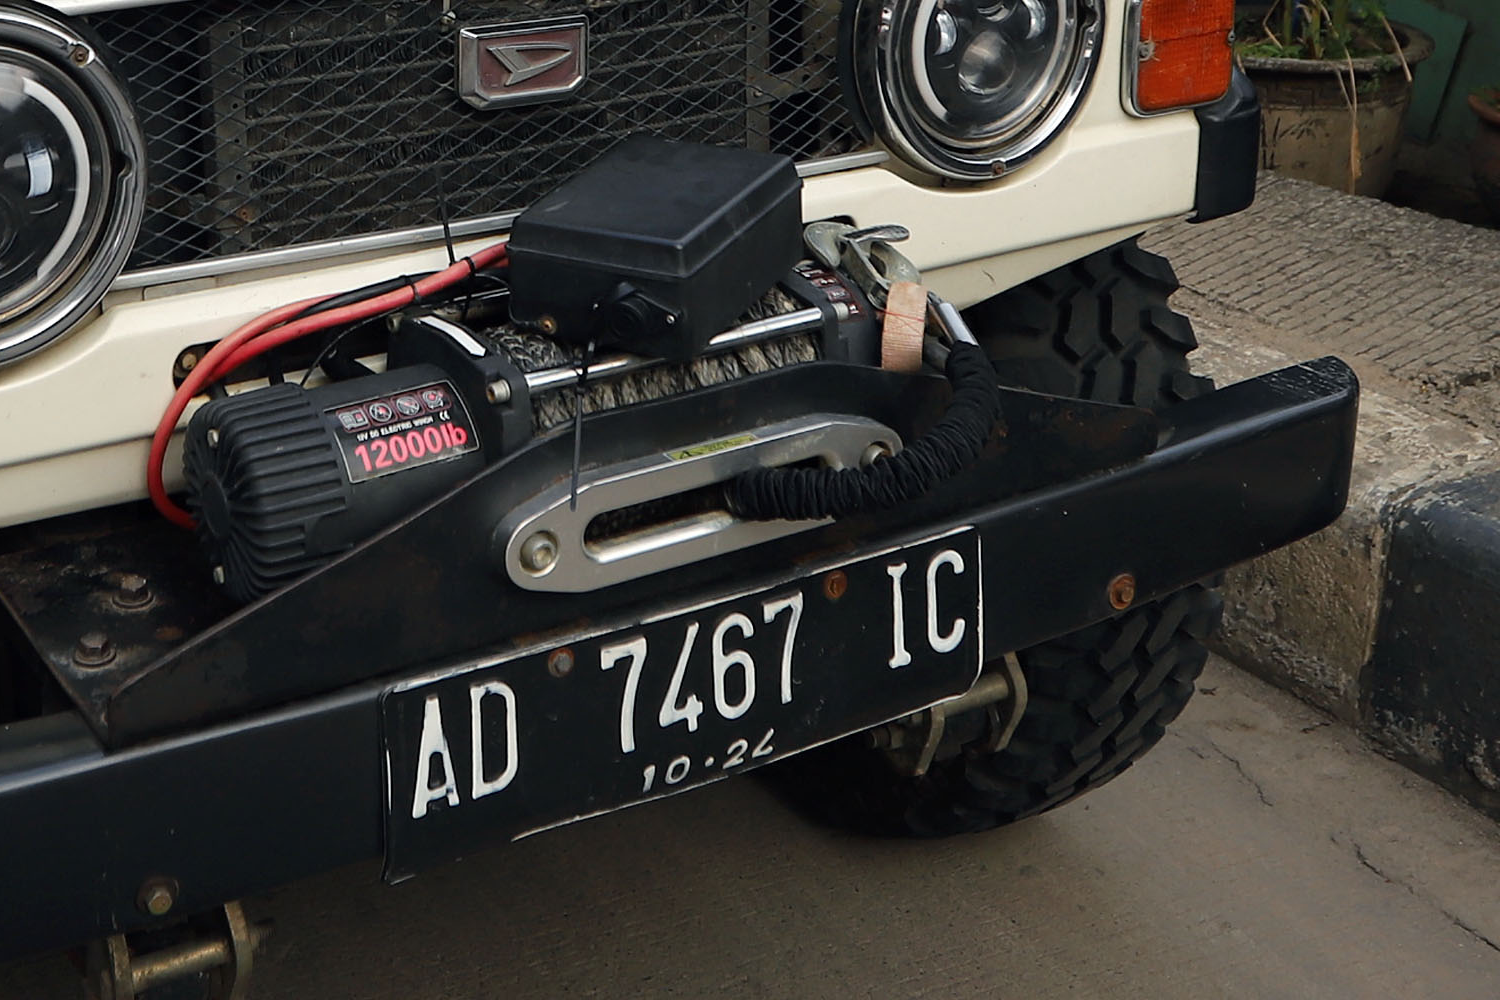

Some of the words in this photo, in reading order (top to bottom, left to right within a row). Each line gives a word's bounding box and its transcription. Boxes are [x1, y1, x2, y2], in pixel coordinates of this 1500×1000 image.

[354, 422, 468, 472] 12000lb
[411, 679, 519, 819] AD
[600, 592, 804, 753] 7467
[886, 548, 967, 669] IC
